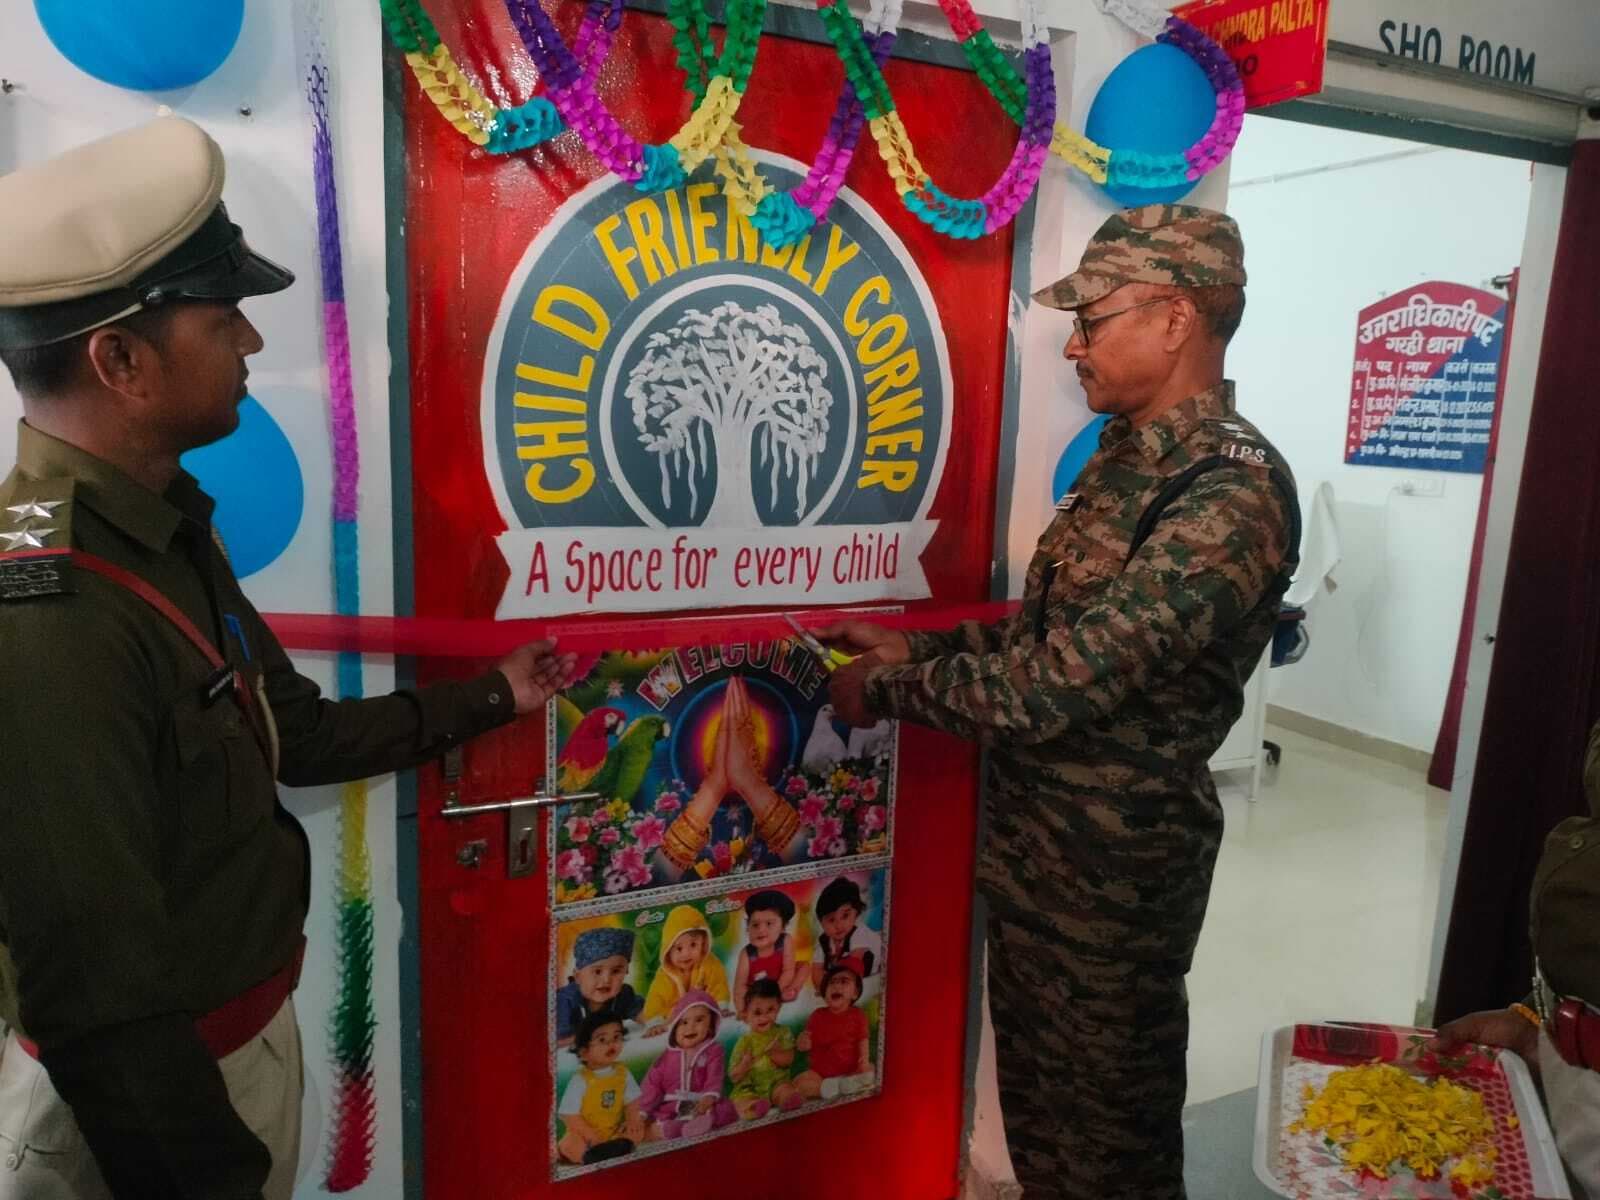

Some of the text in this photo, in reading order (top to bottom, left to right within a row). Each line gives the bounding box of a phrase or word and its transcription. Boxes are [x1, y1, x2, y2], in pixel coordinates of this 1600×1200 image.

[1379, 20, 1537, 85] SHO ROOM
[513, 284, 611, 504] CHILD
[843, 275, 925, 493] CORNER
[526, 532, 899, 604] A Space for every child
[636, 636, 827, 711] WELCOME
